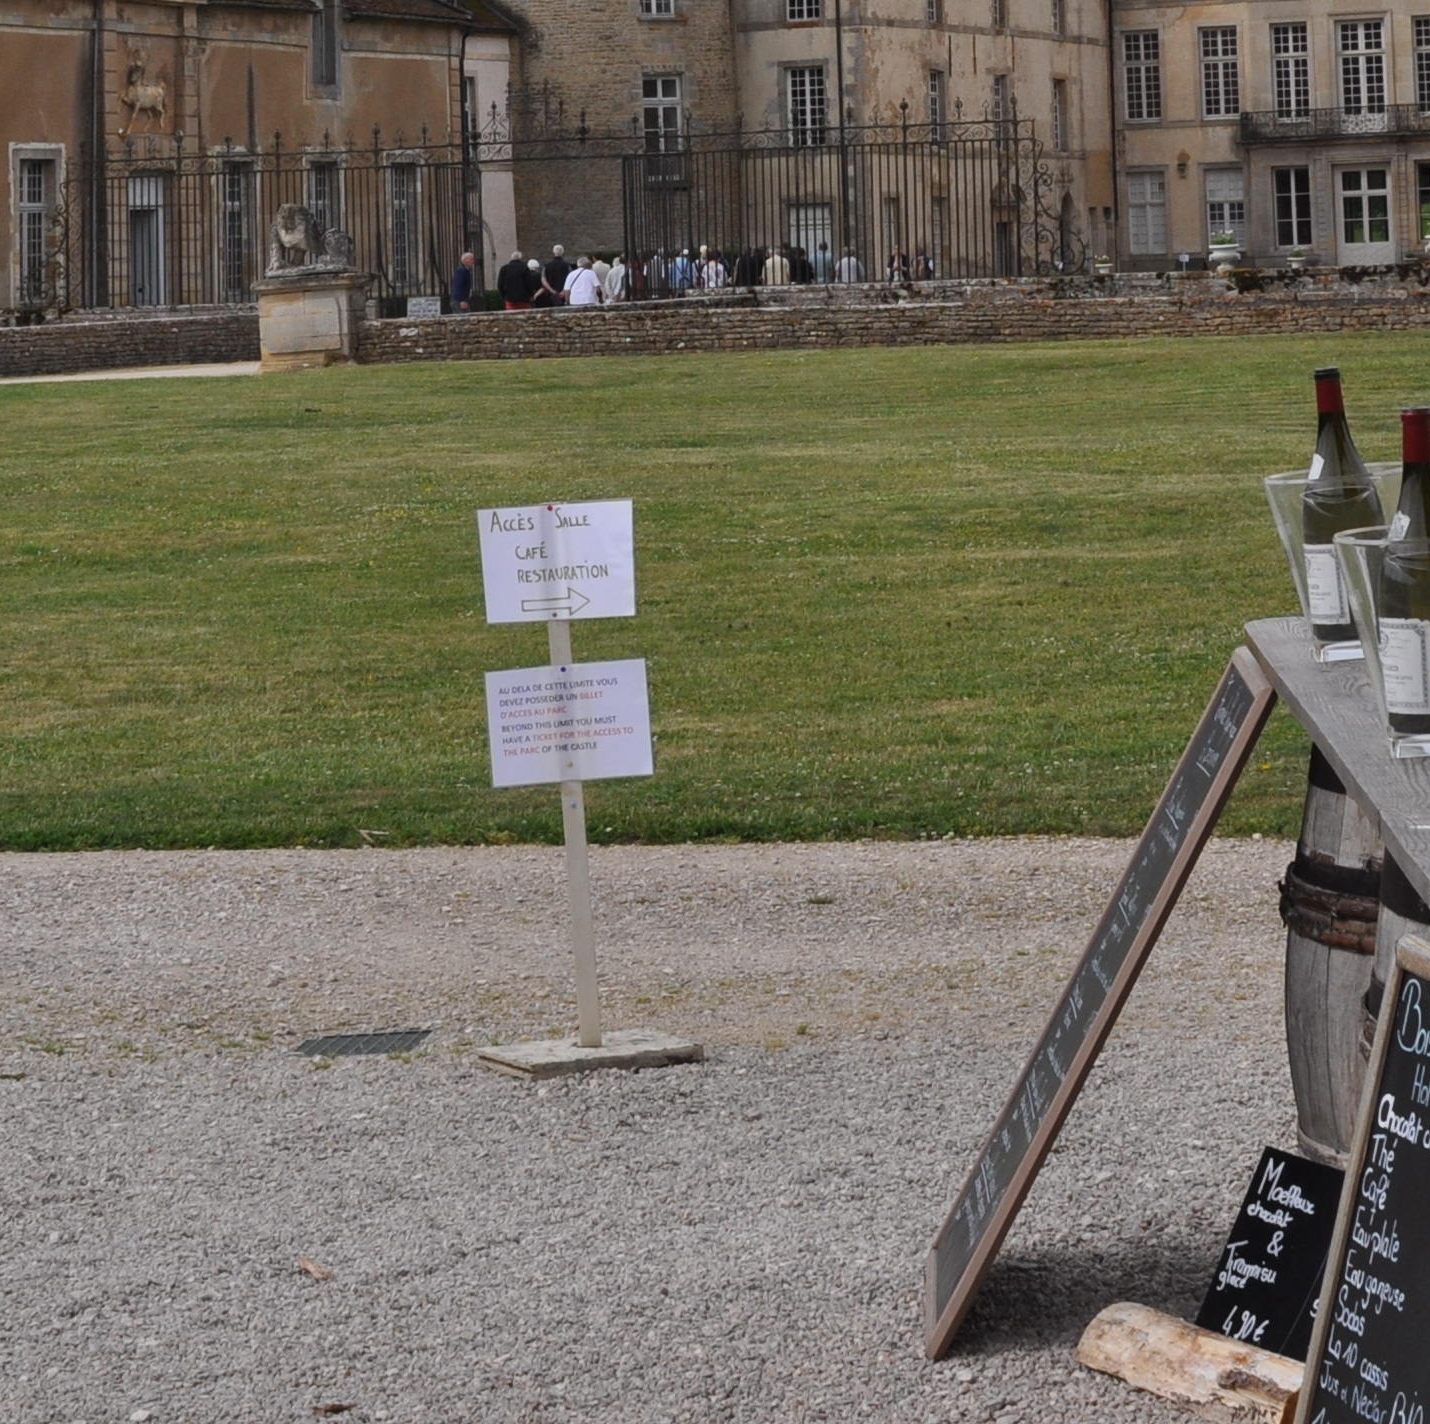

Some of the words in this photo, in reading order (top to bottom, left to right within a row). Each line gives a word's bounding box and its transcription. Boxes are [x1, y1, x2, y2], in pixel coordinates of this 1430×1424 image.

[515, 541, 548, 560] CAFÉ
[517, 560, 609, 583] RESTAURATION
[499, 687, 509, 695] AU
[511, 685, 531, 694] DELA
[532, 684, 542, 692] DE
[545, 682, 567, 691] CETTE
[569, 679, 595, 689] LIMITE
[596, 677, 618, 686] VOUS
[499, 698, 523, 707] DEVEZ
[525, 694, 564, 705] POSSEDER
[566, 693, 578, 701] UN
[579, 691, 603, 700] BILLET
[500, 709, 532, 719] D'ACCES
[534, 708, 545, 716] AU
[547, 706, 567, 715] PARC
[502, 723, 533, 733] BEYOND
[535, 721, 552, 729] THIS
[554, 719, 574, 728] LIMIT
[576, 717, 592, 726] YOU
[594, 716, 617, 725] MUST
[502, 736, 523, 745] HAVE
[524, 735, 531, 743] A
[532, 732, 558, 742] TICKET
[559, 731, 575, 739] FOR
[577, 730, 591, 738] THE
[593, 727, 621, 736] ACCESS
[504, 748, 519, 756] THE
[520, 746, 540, 755] PARC
[542, 745, 552, 753] OF
[555, 744, 569, 752] THE
[571, 741, 598, 751] CASTLE
[1377, 1093, 1424, 1145] Chocolat
[1372, 1134, 1398, 1173] Thé
[1266, 1230, 1284, 1258] &
[1351, 1205, 1370, 1250] Eau
[1369, 1219, 1400, 1265] plate
[1344, 1249, 1365, 1290] Eau
[1335, 1284, 1366, 1337] Sodas
[1320, 1360, 1340, 1398] Jus
[1359, 1356, 1389, 1392] cassis
